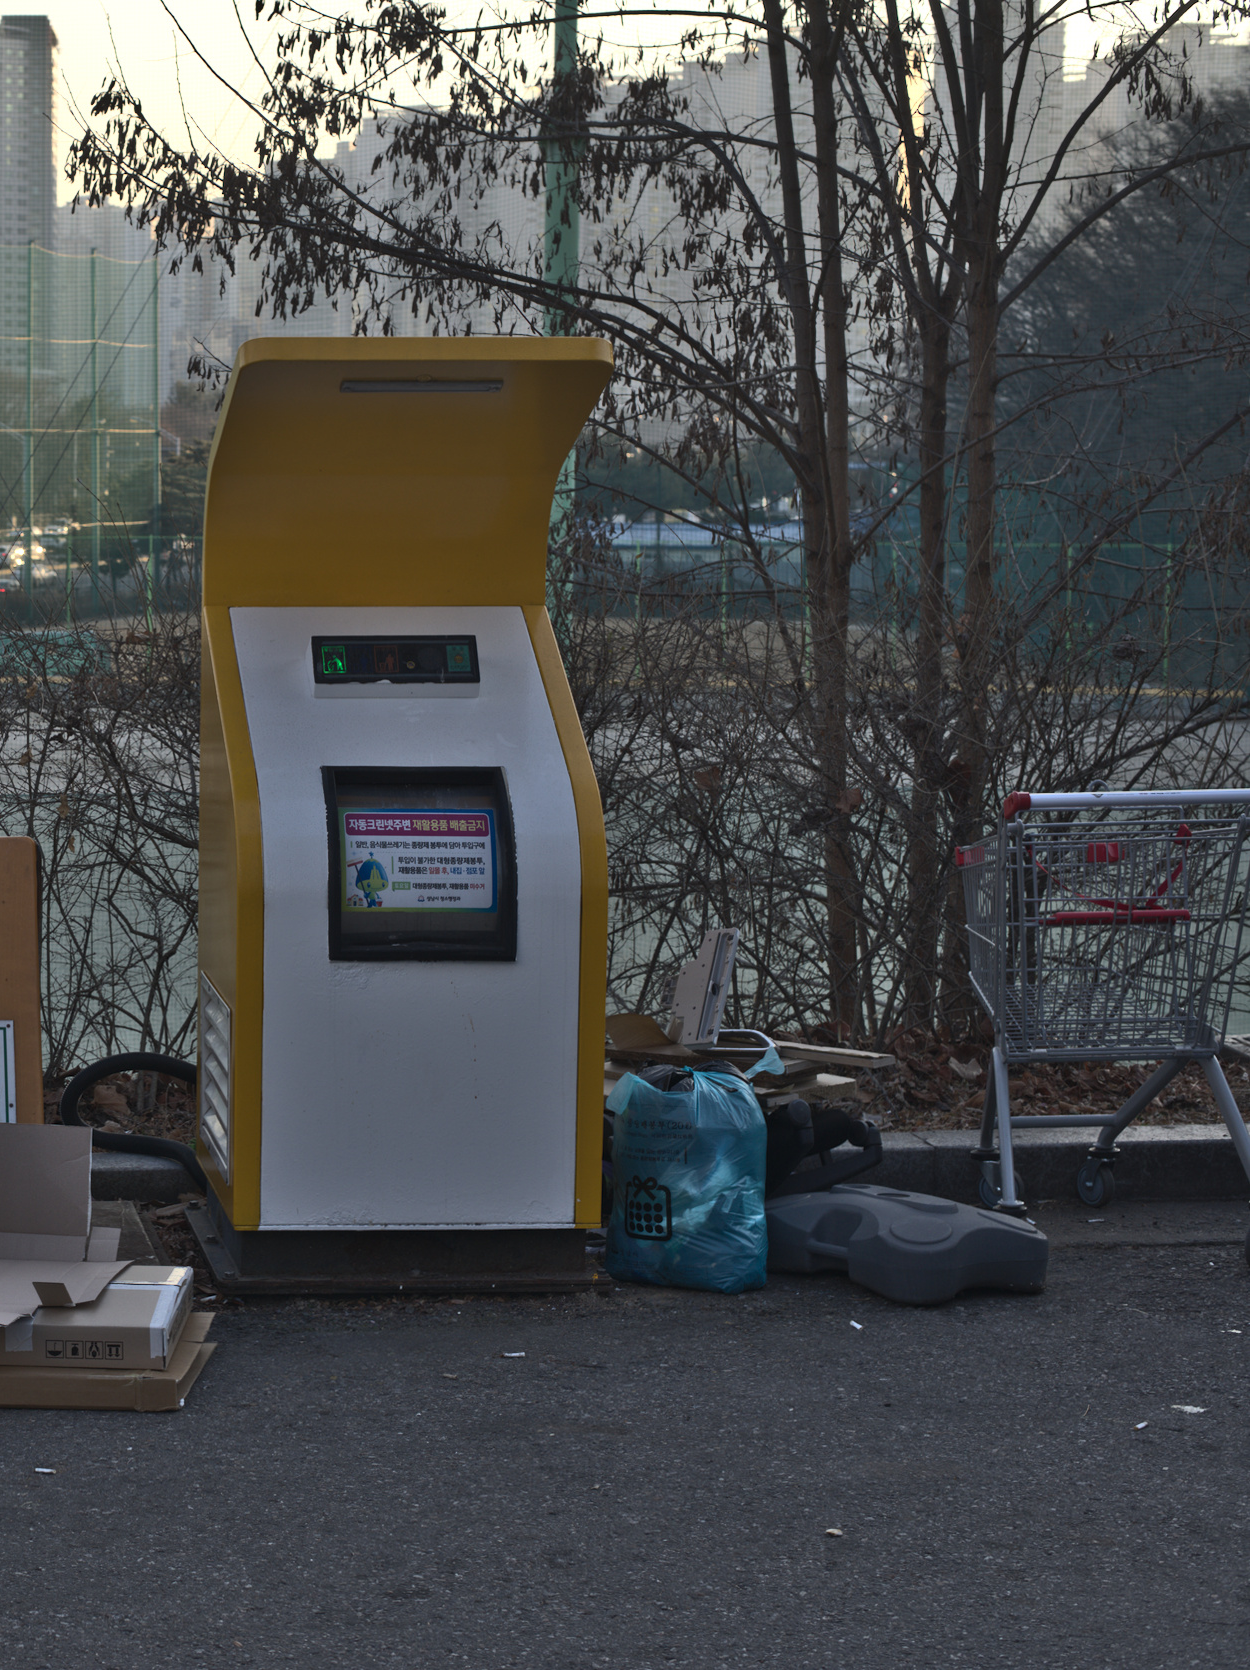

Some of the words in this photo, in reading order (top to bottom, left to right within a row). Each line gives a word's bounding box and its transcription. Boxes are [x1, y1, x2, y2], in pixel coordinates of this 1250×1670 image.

[349, 819, 411, 831] 자동크린넷주변
[412, 819, 448, 831] 재활용품
[450, 820, 485, 832] 배출금지
[355, 841, 369, 849] 일반,
[370, 841, 411, 849] 음식물쓰레기는
[411, 841, 430, 849] 종량제
[430, 841, 448, 849] 봉투에
[449, 841, 461, 849] 담아
[461, 841, 486, 850] 투입구에
[397, 856, 416, 864] 투입이
[417, 856, 436, 865] 불가한
[436, 856, 485, 865] 대형종량제봉투,
[398, 867, 428, 875] 재활용품은
[428, 867, 441, 875] 일몰
[449, 882, 469, 890] 재활용품
[469, 882, 485, 890] 미수거
